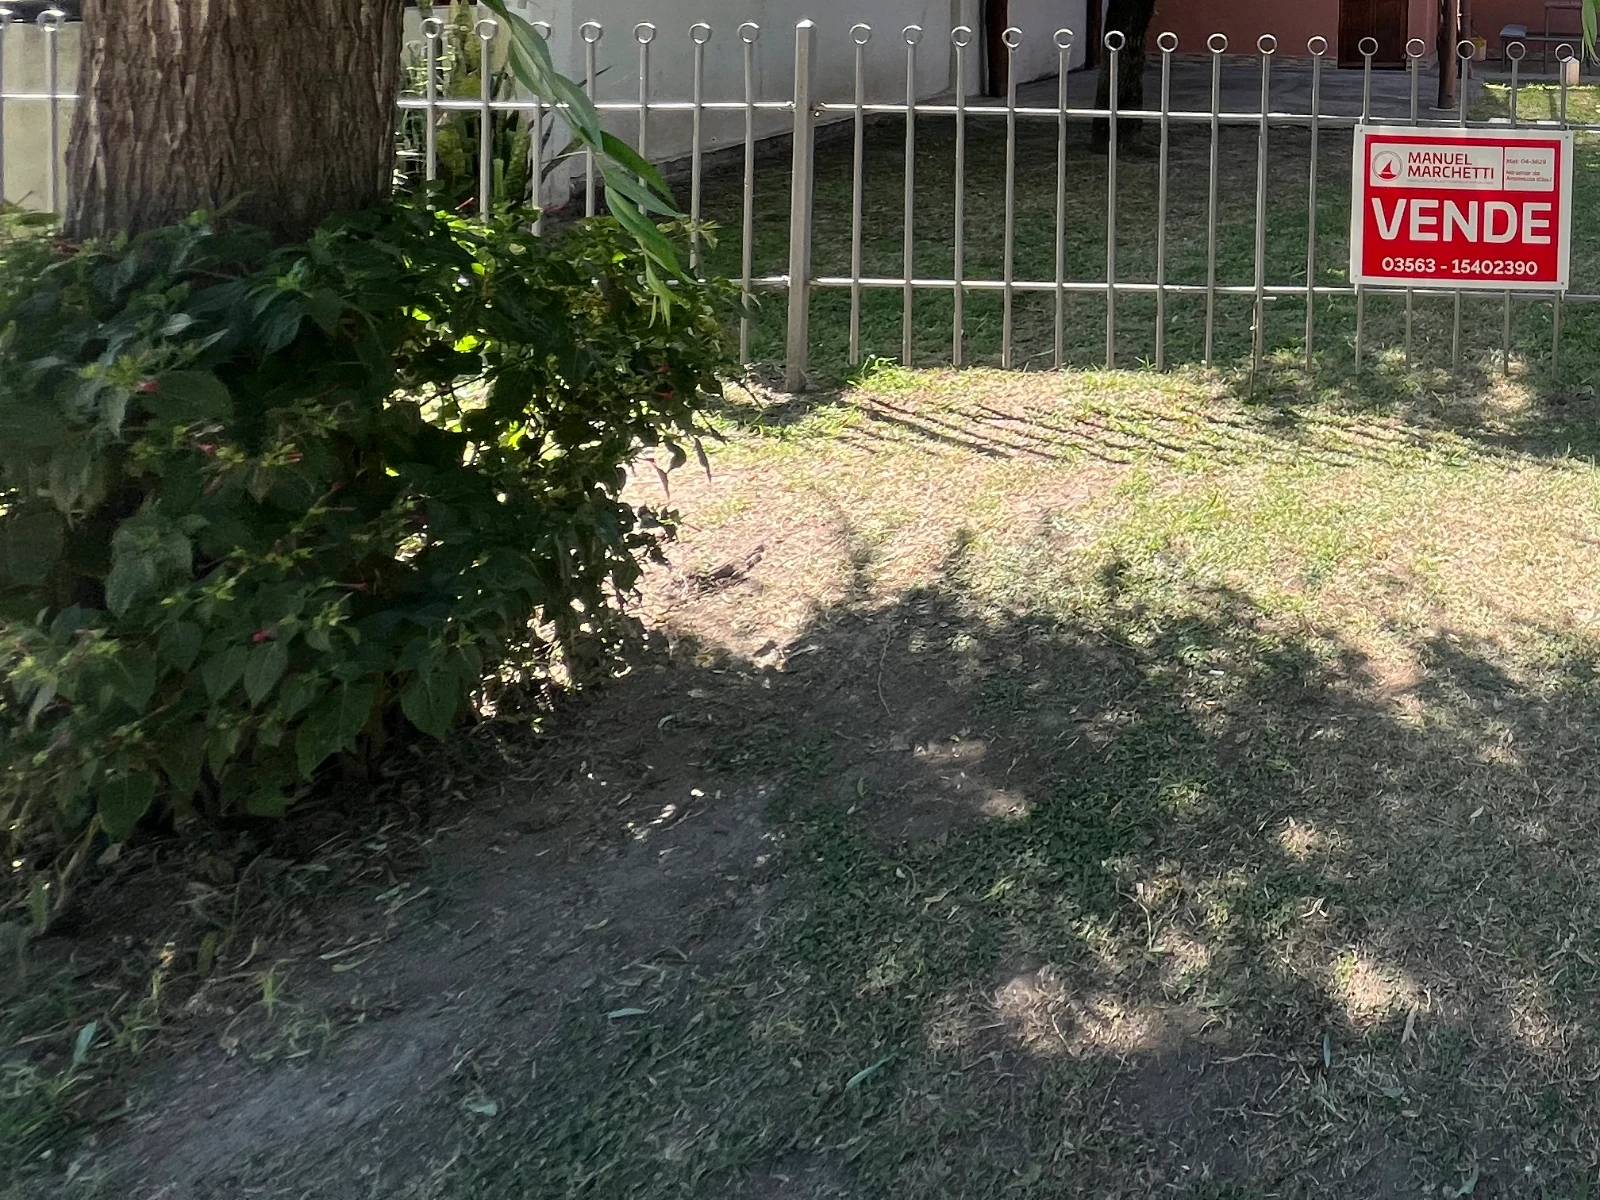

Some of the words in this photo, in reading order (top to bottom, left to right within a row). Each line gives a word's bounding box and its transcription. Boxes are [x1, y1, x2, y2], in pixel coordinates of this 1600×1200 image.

[1408, 152, 1472, 166] MANUEL
[1407, 166, 1494, 180] MARCHETTI
[1371, 197, 1552, 244] VENDE
[1382, 257, 1436, 273] 03563
[1452, 259, 1538, 276] 15402390
